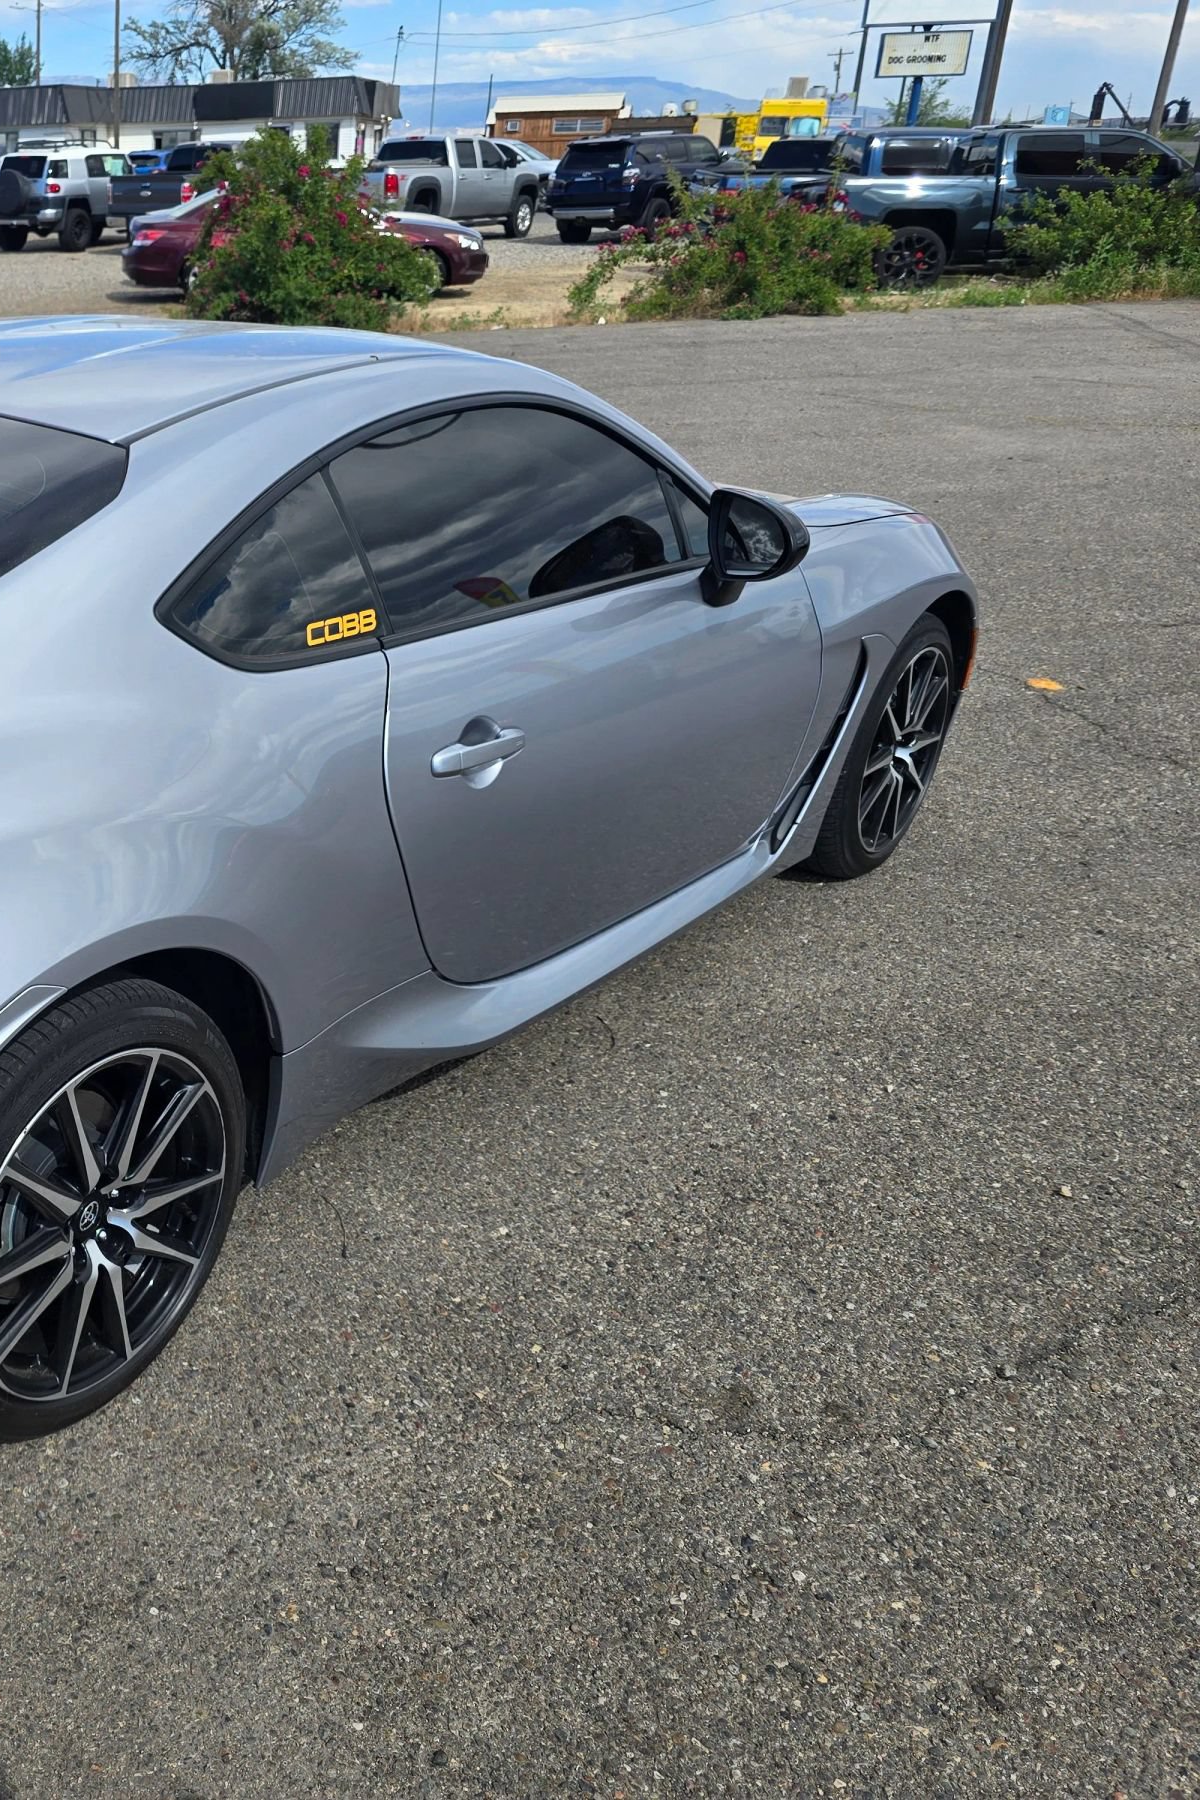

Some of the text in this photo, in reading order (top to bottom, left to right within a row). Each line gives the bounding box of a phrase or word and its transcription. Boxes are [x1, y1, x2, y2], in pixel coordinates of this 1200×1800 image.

[924, 34, 940, 43] WTF
[906, 54, 947, 64] GROOMING
[306, 608, 377, 647] COBB
